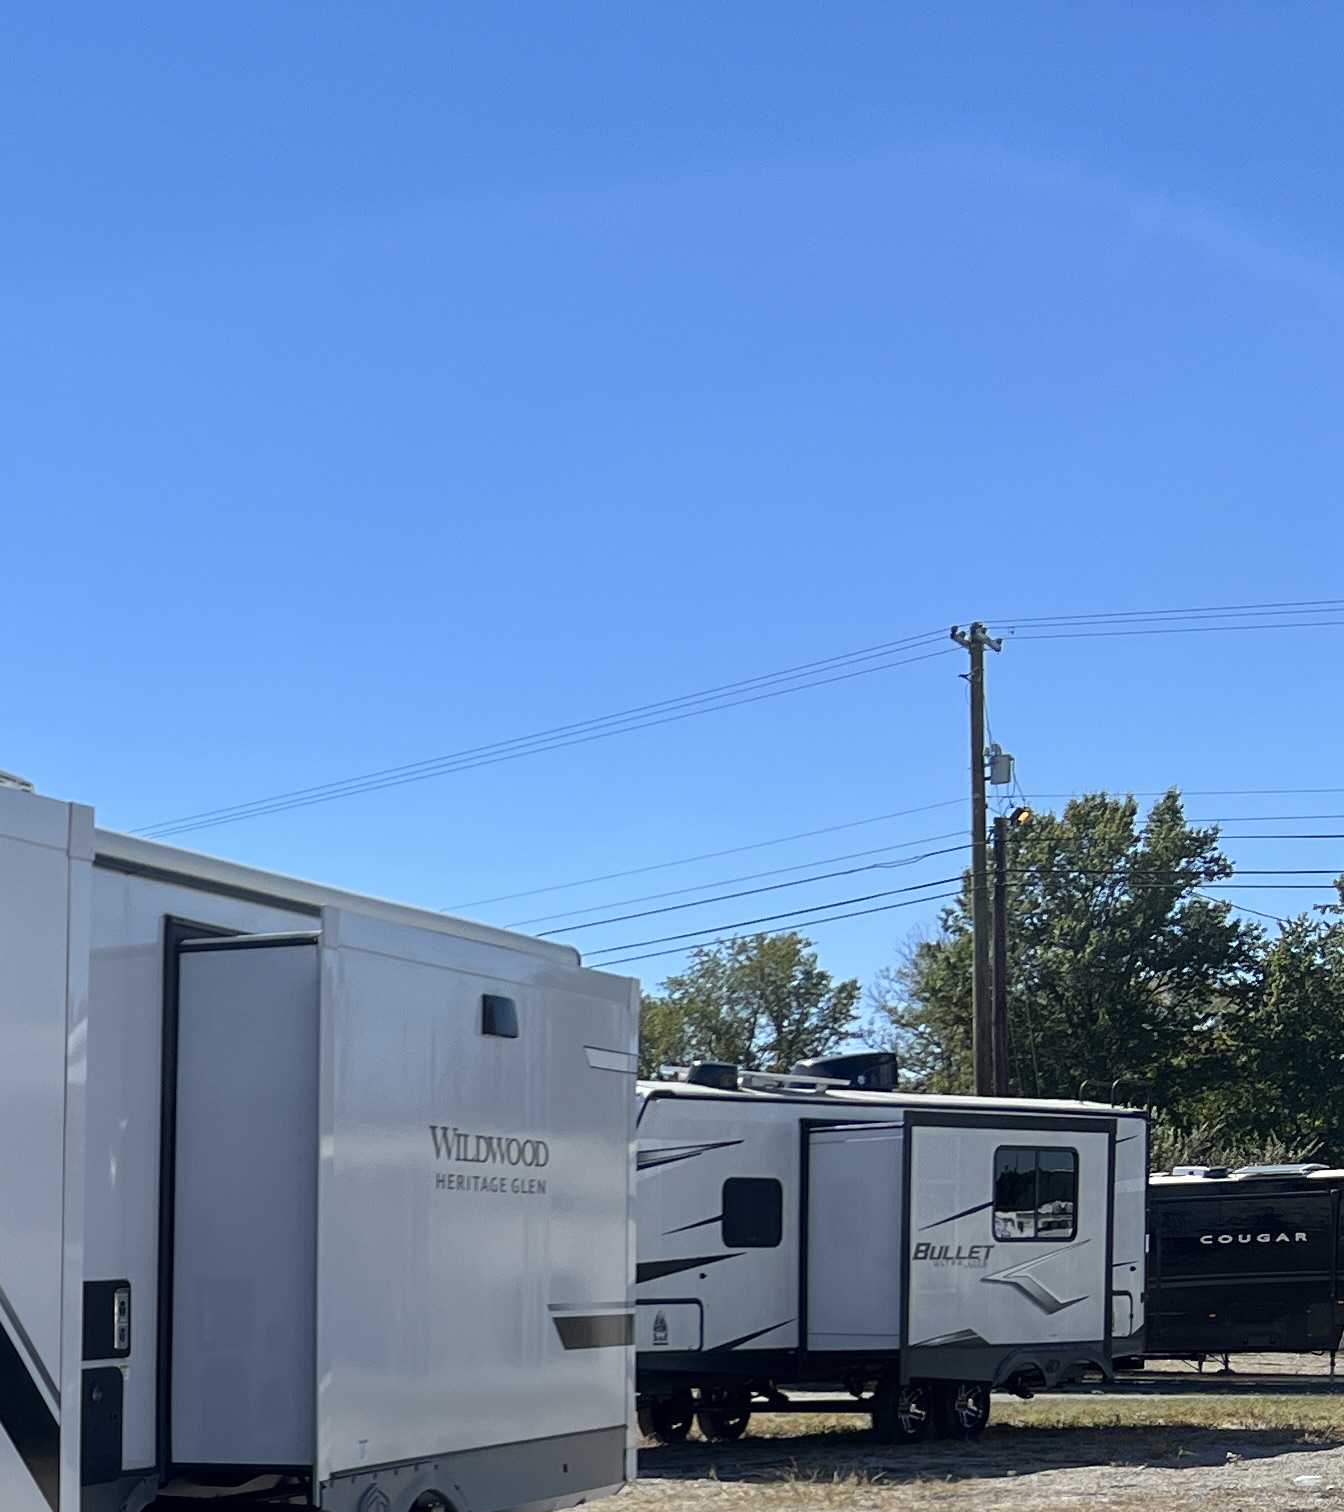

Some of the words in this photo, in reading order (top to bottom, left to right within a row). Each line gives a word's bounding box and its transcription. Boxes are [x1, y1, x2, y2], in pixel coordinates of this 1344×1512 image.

[429, 1125, 549, 1168] WILDWOOD
[435, 1173, 508, 1193] HERITAGE
[511, 1177, 548, 1194] GLEN
[1199, 1232, 1308, 1245] COUGAR
[913, 1242, 996, 1260] BULLET
